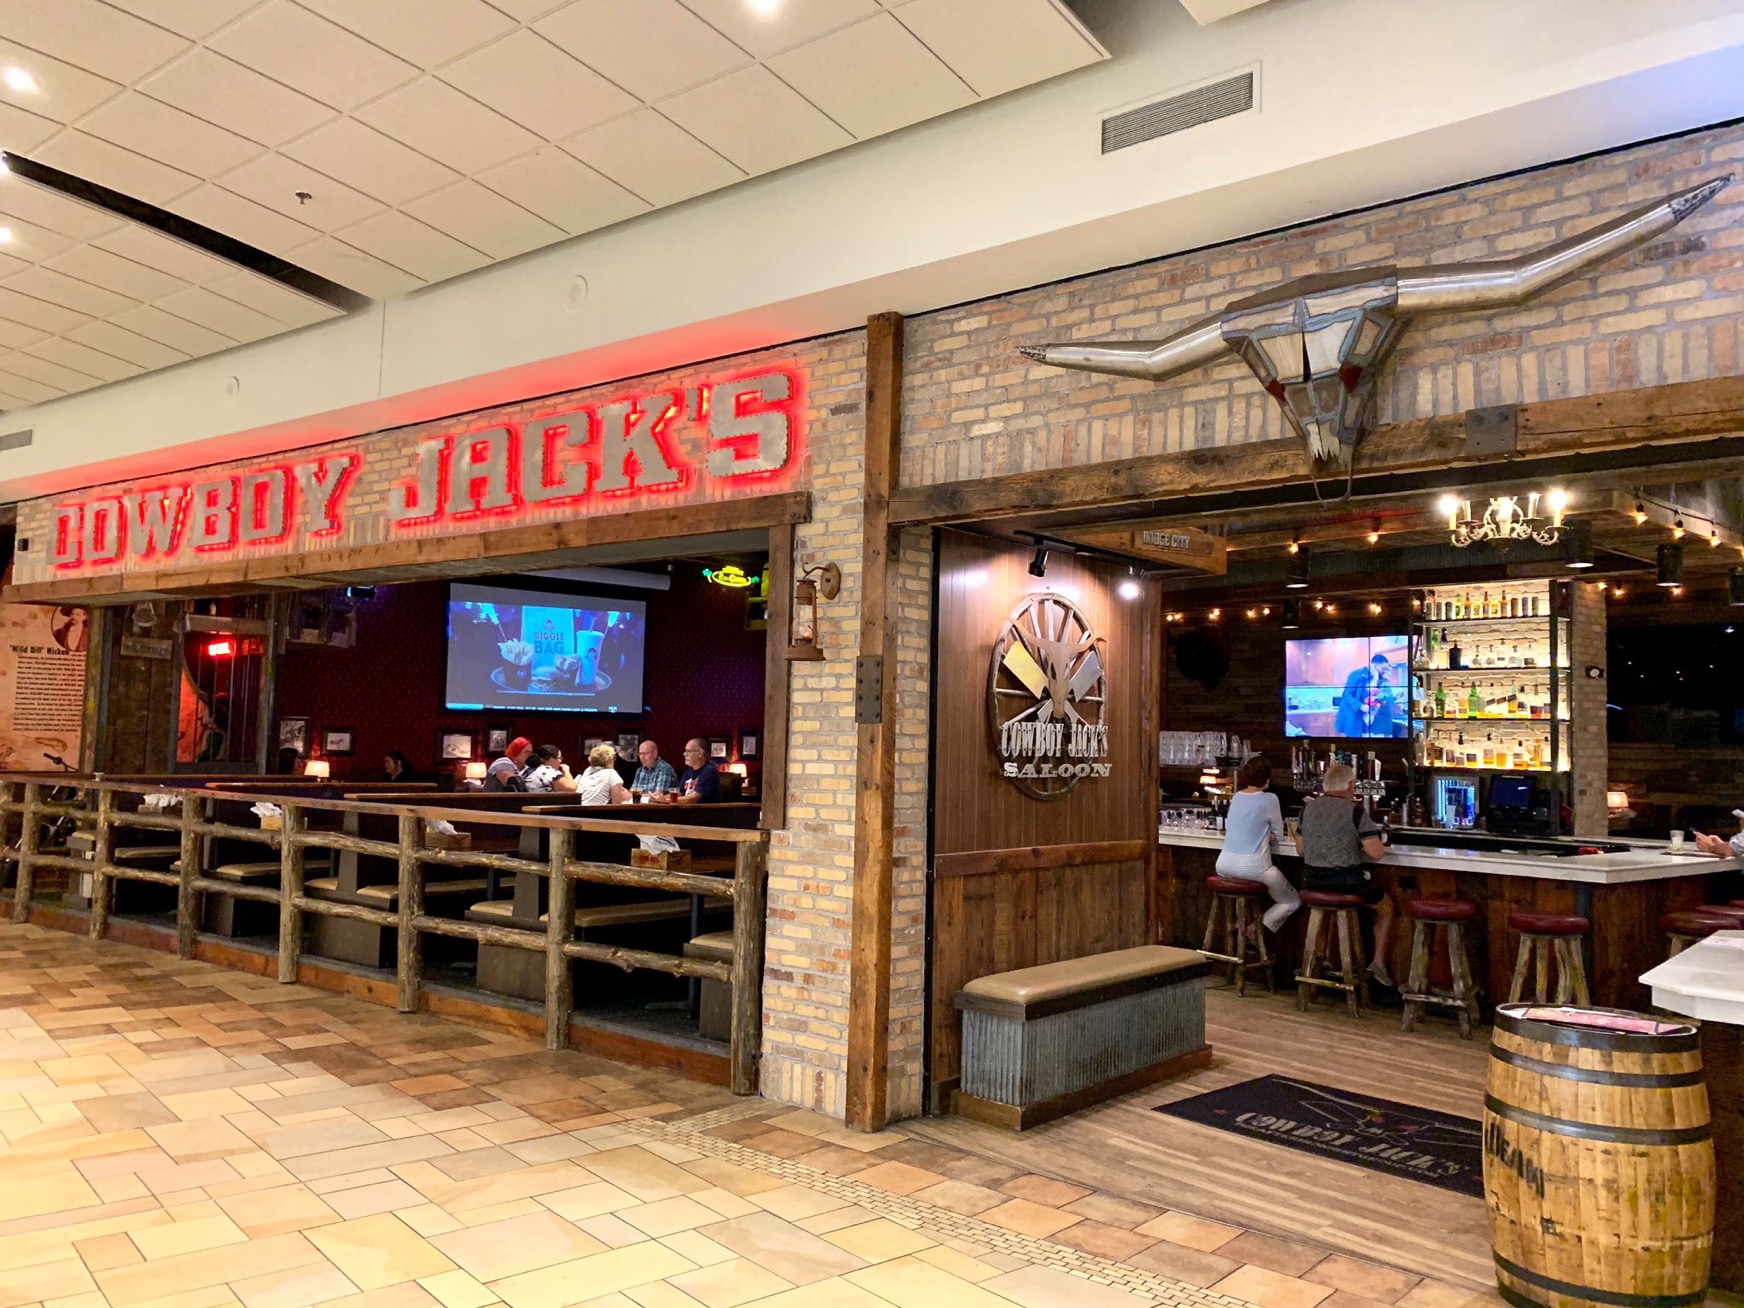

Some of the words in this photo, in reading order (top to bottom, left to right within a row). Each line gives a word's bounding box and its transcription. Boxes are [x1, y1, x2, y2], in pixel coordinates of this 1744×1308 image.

[45, 454, 360, 568] COWBOY
[389, 371, 796, 526] JACK'S
[1143, 530, 1170, 547] DODGE
[1171, 534, 1191, 549] CITY
[534, 632, 565, 640] BIGGIE
[534, 641, 565, 654] BAG
[1001, 721, 1064, 757] COWBOY
[1067, 723, 1109, 758] JACK'S
[1003, 762, 1113, 778] SALOON
